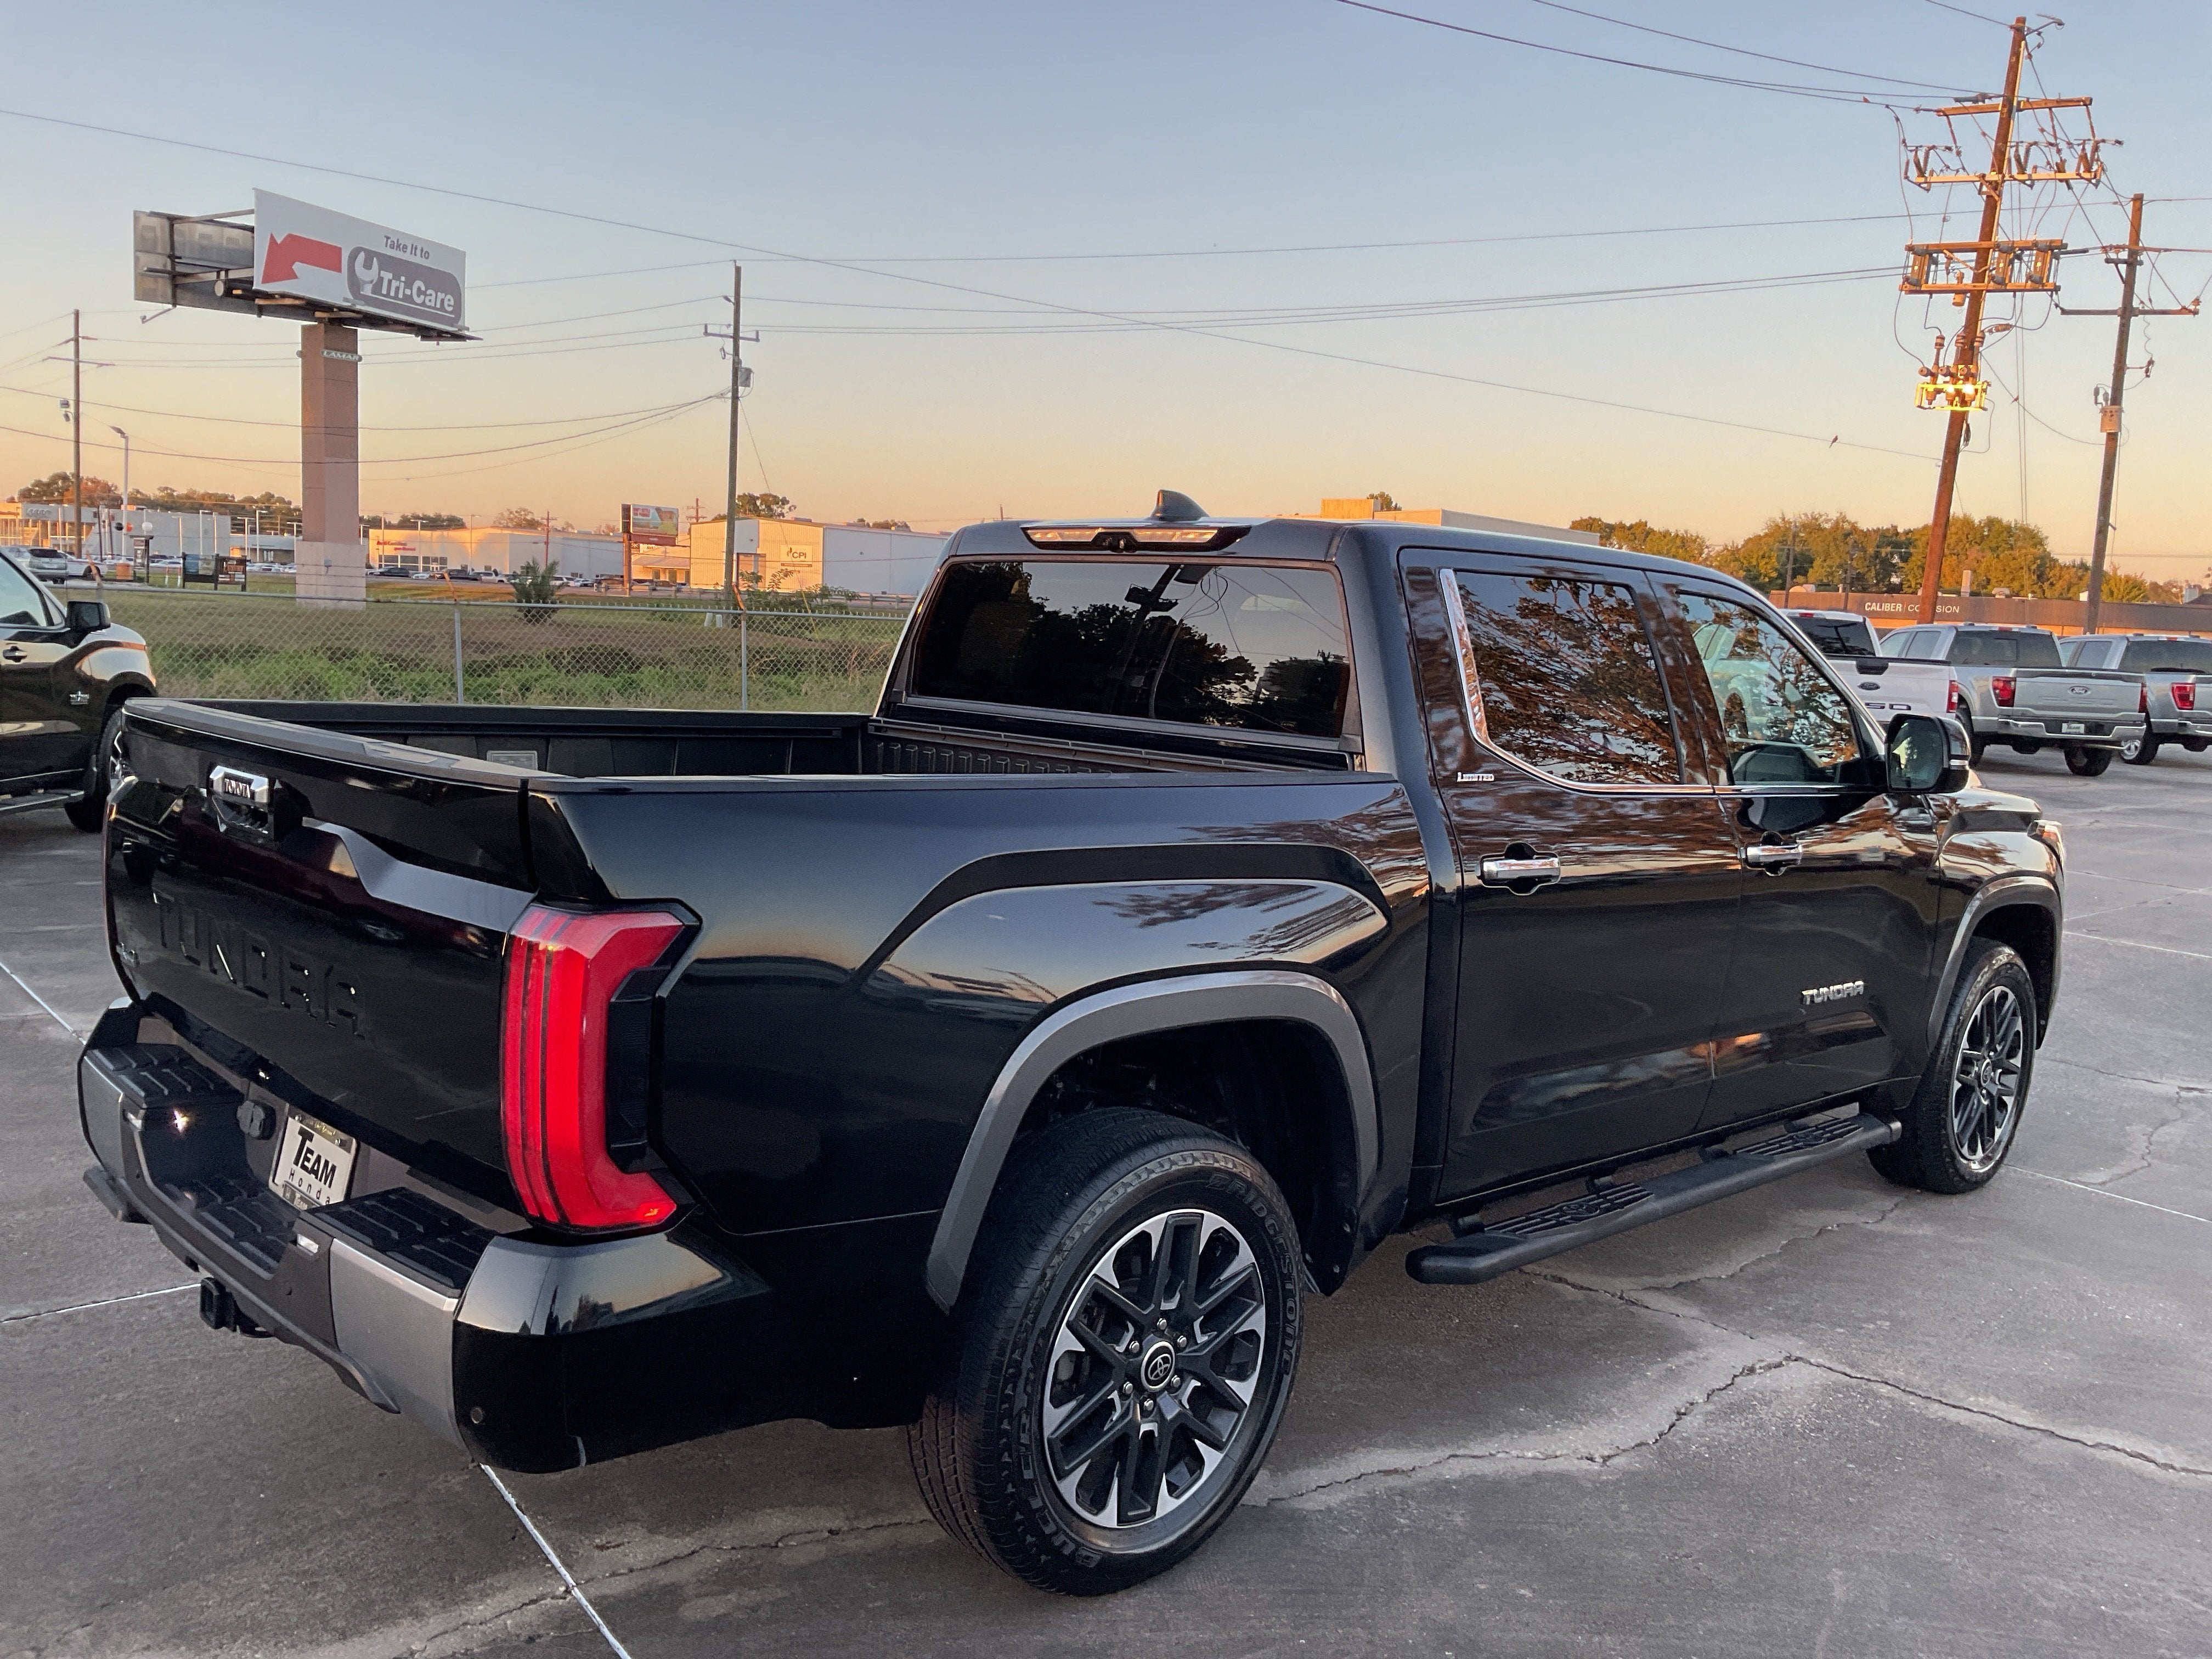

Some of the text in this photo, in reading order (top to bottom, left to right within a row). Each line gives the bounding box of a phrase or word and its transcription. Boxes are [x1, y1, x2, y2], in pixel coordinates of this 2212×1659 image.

[385, 235, 430, 259] Take It to
[380, 270, 454, 312] Tri-Care
[323, 351, 359, 361] LAMAR
[1865, 602, 1960, 613] CALIBER COSION
[224, 778, 251, 798] TOYOTA
[151, 887, 366, 1040] TUNDRA
[1802, 980, 1864, 1005] TUNDRA
[293, 1125, 337, 1189] TEAM
[289, 1167, 330, 1205] Honda
[1205, 1172, 1298, 1376] BRIDGESTONE
